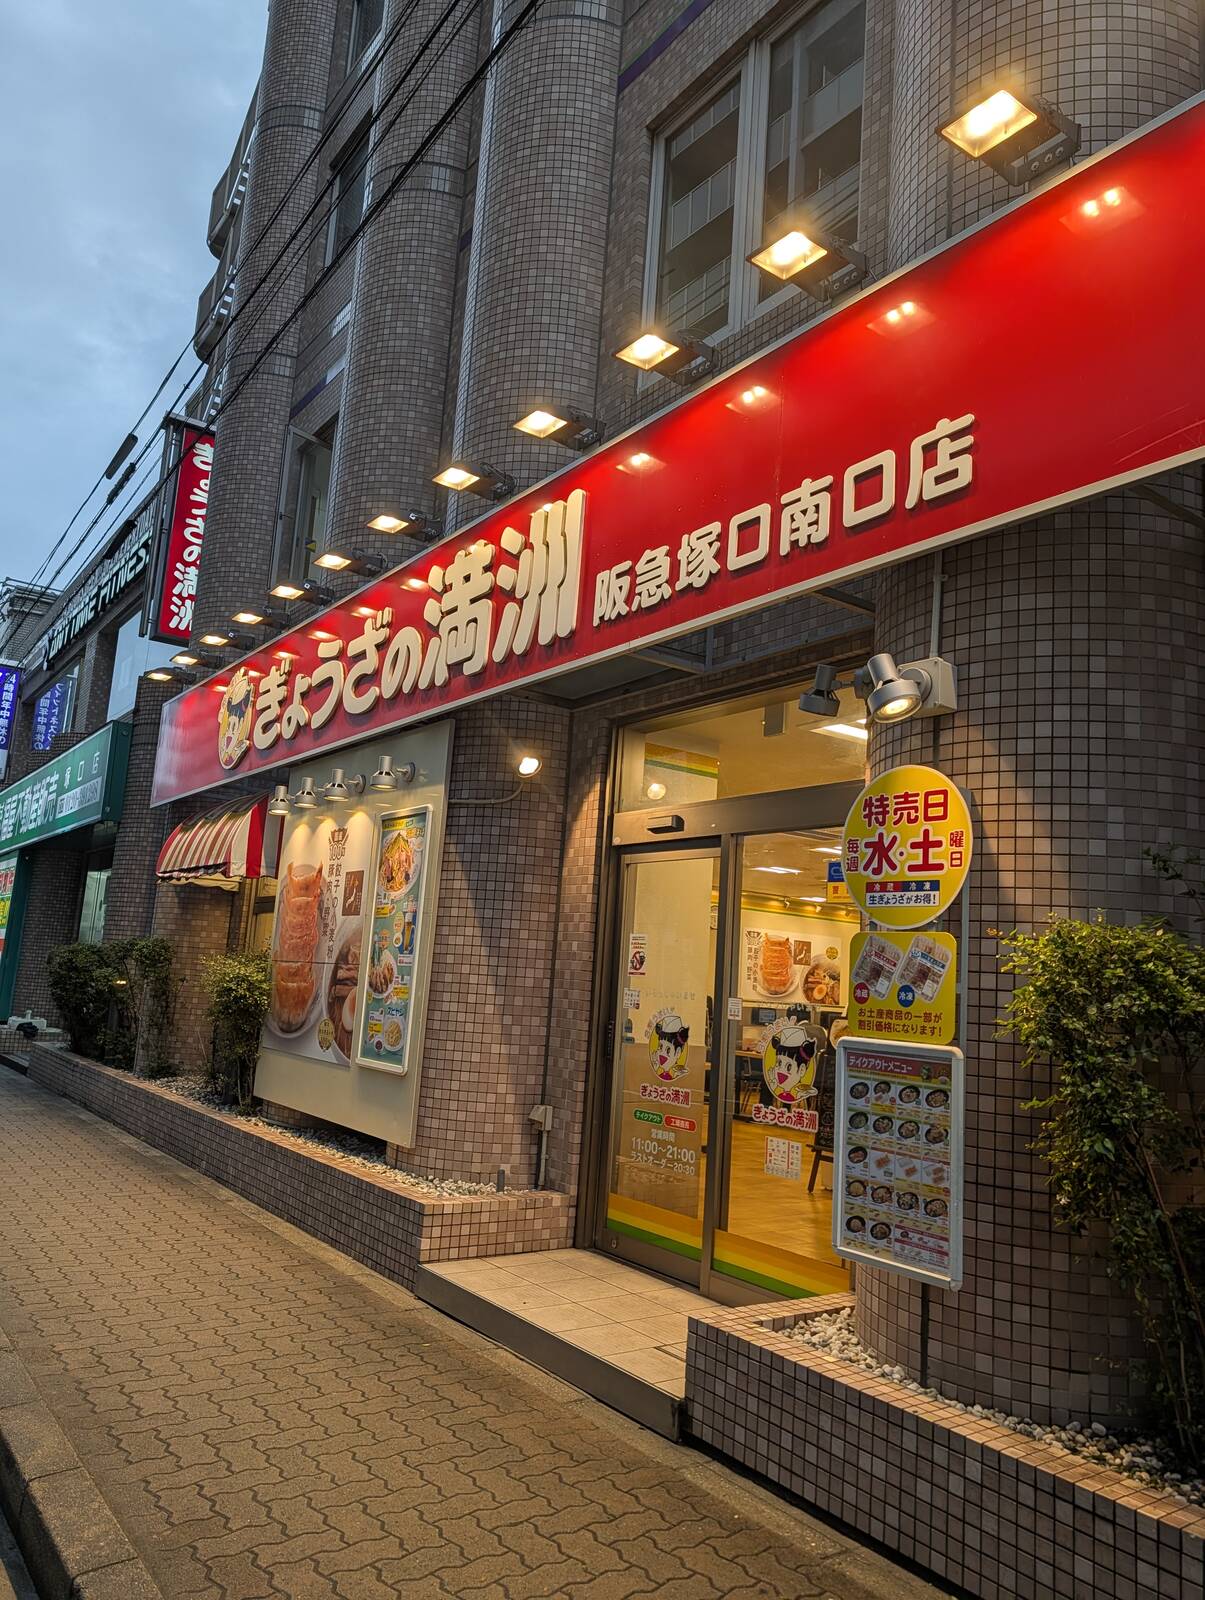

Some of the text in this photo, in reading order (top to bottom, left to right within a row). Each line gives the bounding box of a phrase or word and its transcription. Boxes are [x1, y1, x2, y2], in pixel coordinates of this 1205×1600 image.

[594, 413, 976, 627] 阪急塚口南口店
[48, 588, 99, 660] ANYTIME
[252, 488, 587, 750] ぎょうざの満洲
[862, 788, 949, 828] 特売日
[846, 838, 860, 872] 毎週
[862, 828, 945, 876] 水・土
[949, 830, 965, 868] 曜日
[857, 1008, 943, 1024] お土産商品の一部が
[848, 1055, 913, 1073] テイクアウトメニュー
[640, 1084, 691, 1106] ぎょうざの満洲
[752, 1105, 817, 1131] ぎょうざの満洲
